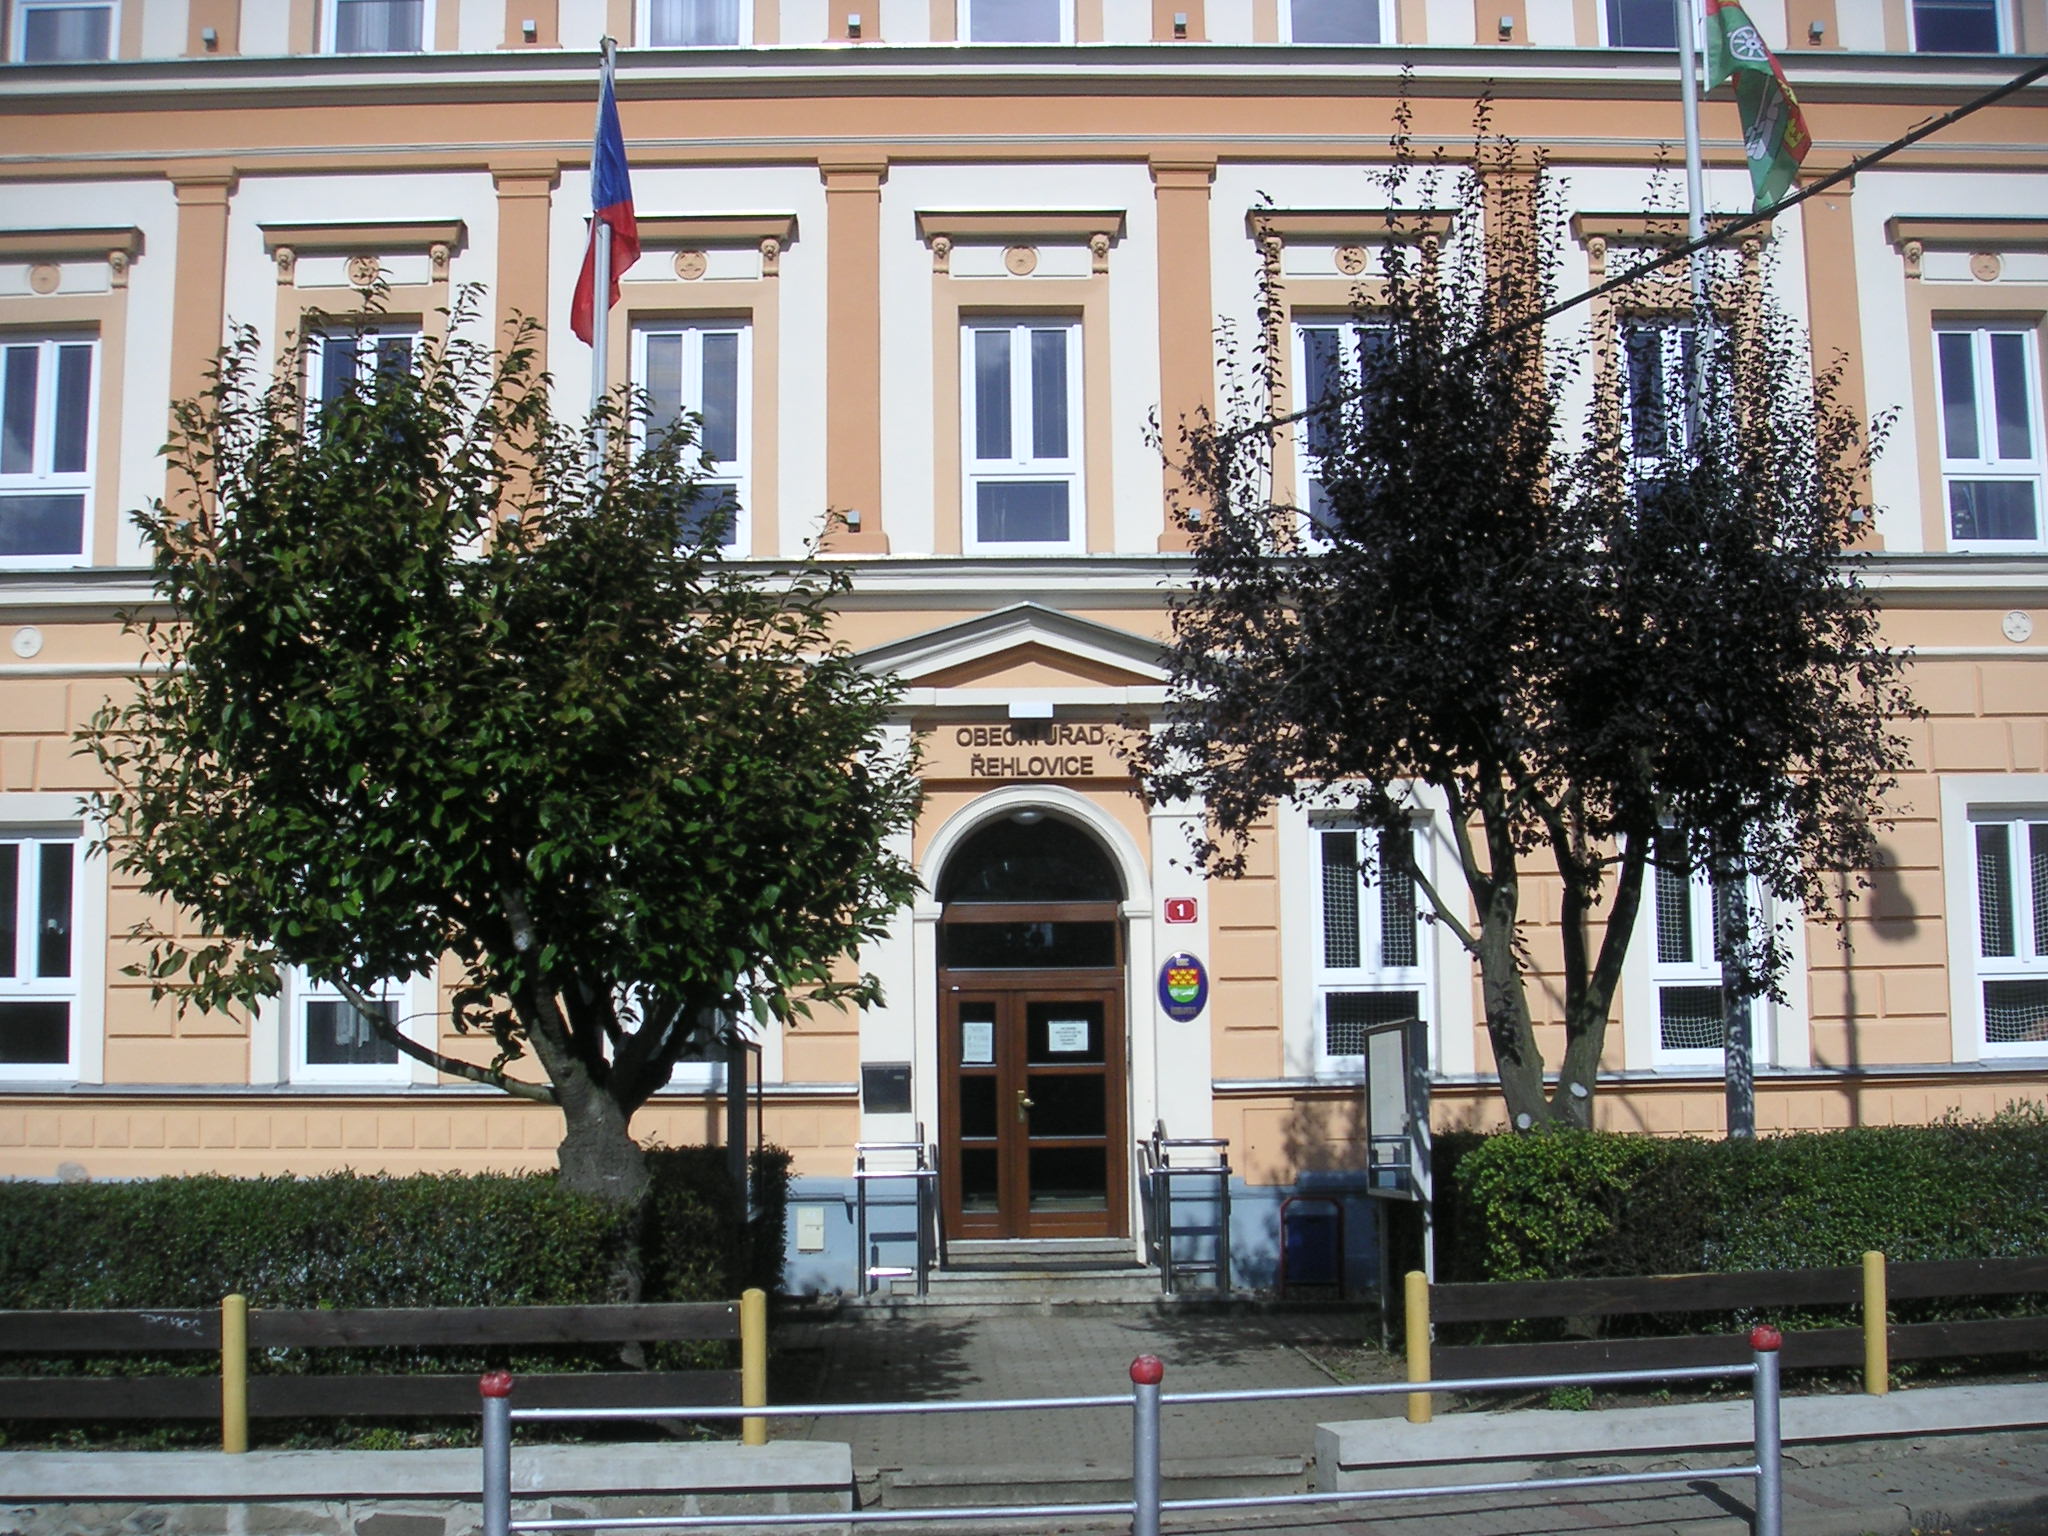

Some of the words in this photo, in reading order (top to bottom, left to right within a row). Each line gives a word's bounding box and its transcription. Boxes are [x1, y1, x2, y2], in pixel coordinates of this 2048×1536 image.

[956, 727, 1038, 746] OBEC
[970, 753, 1093, 776] ŘEHLOVICE
[1176, 903, 1185, 917] 1
